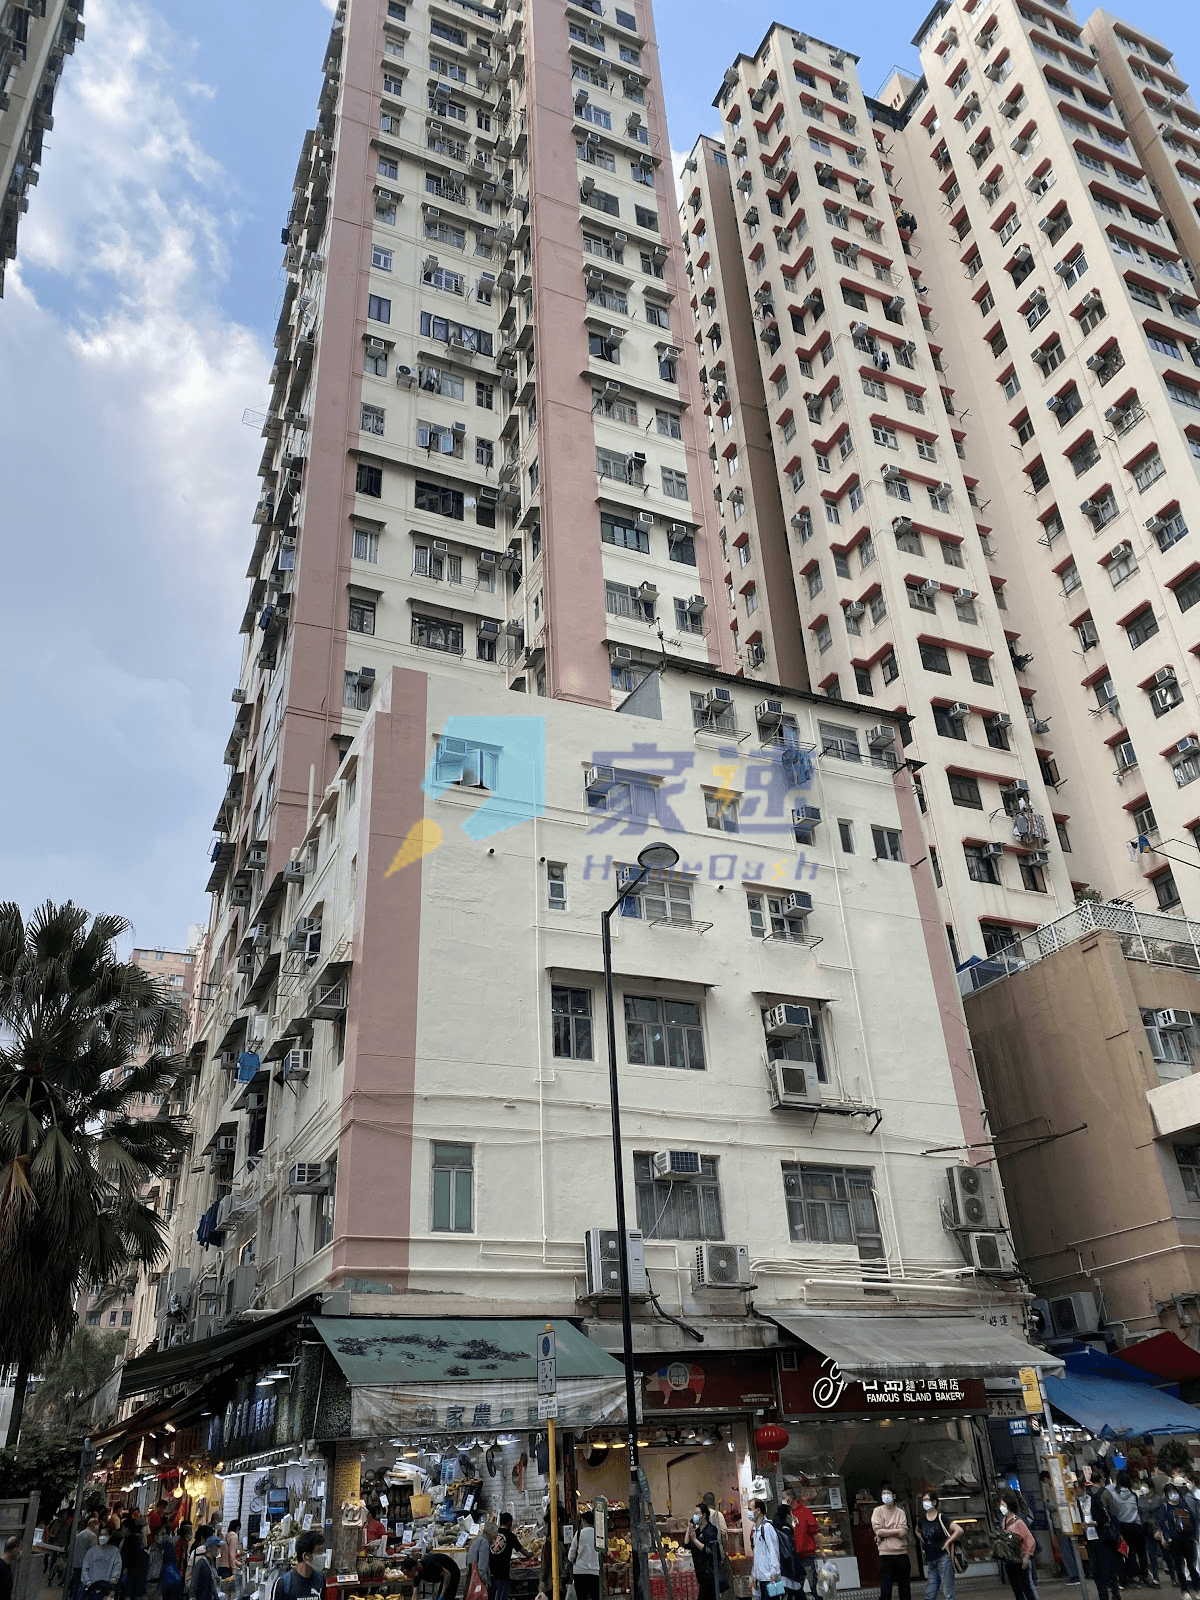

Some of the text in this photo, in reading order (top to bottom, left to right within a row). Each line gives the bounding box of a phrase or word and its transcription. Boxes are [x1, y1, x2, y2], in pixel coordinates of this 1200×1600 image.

[866, 1391, 965, 1403] FAMOUS ISLAND BAKERY
